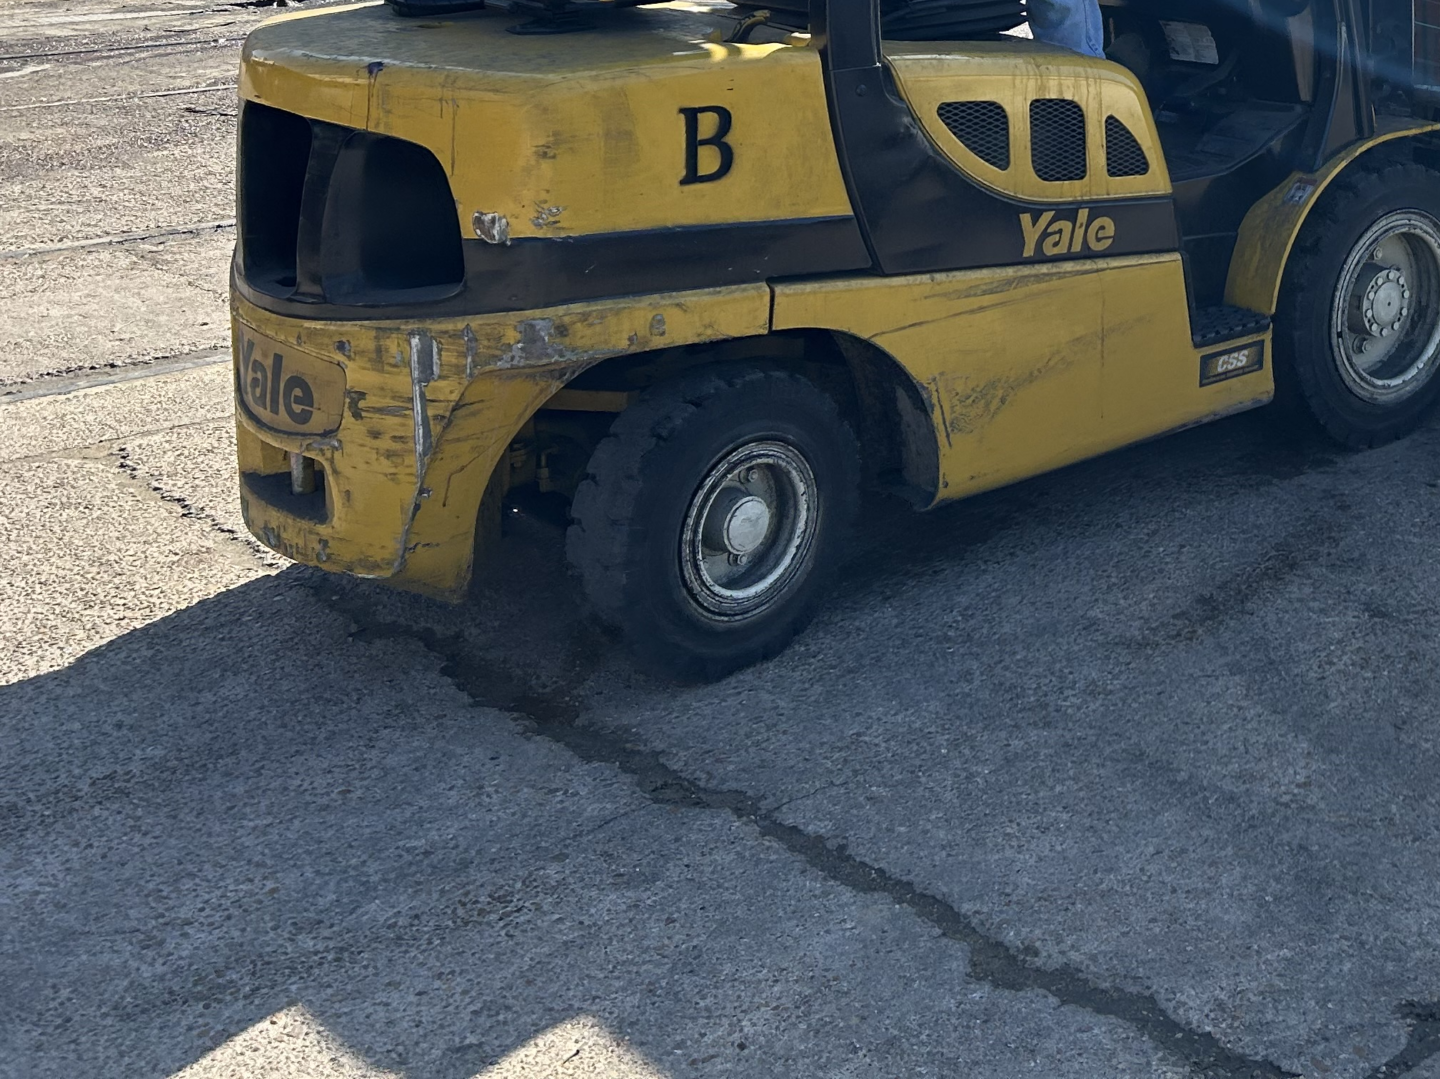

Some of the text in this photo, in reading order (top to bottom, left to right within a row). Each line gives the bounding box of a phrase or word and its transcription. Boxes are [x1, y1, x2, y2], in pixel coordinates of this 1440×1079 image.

[678, 105, 733, 185] B
[1019, 208, 1115, 257] Yale
[240, 328, 314, 426] Yale
[1217, 349, 1249, 372] CSS
